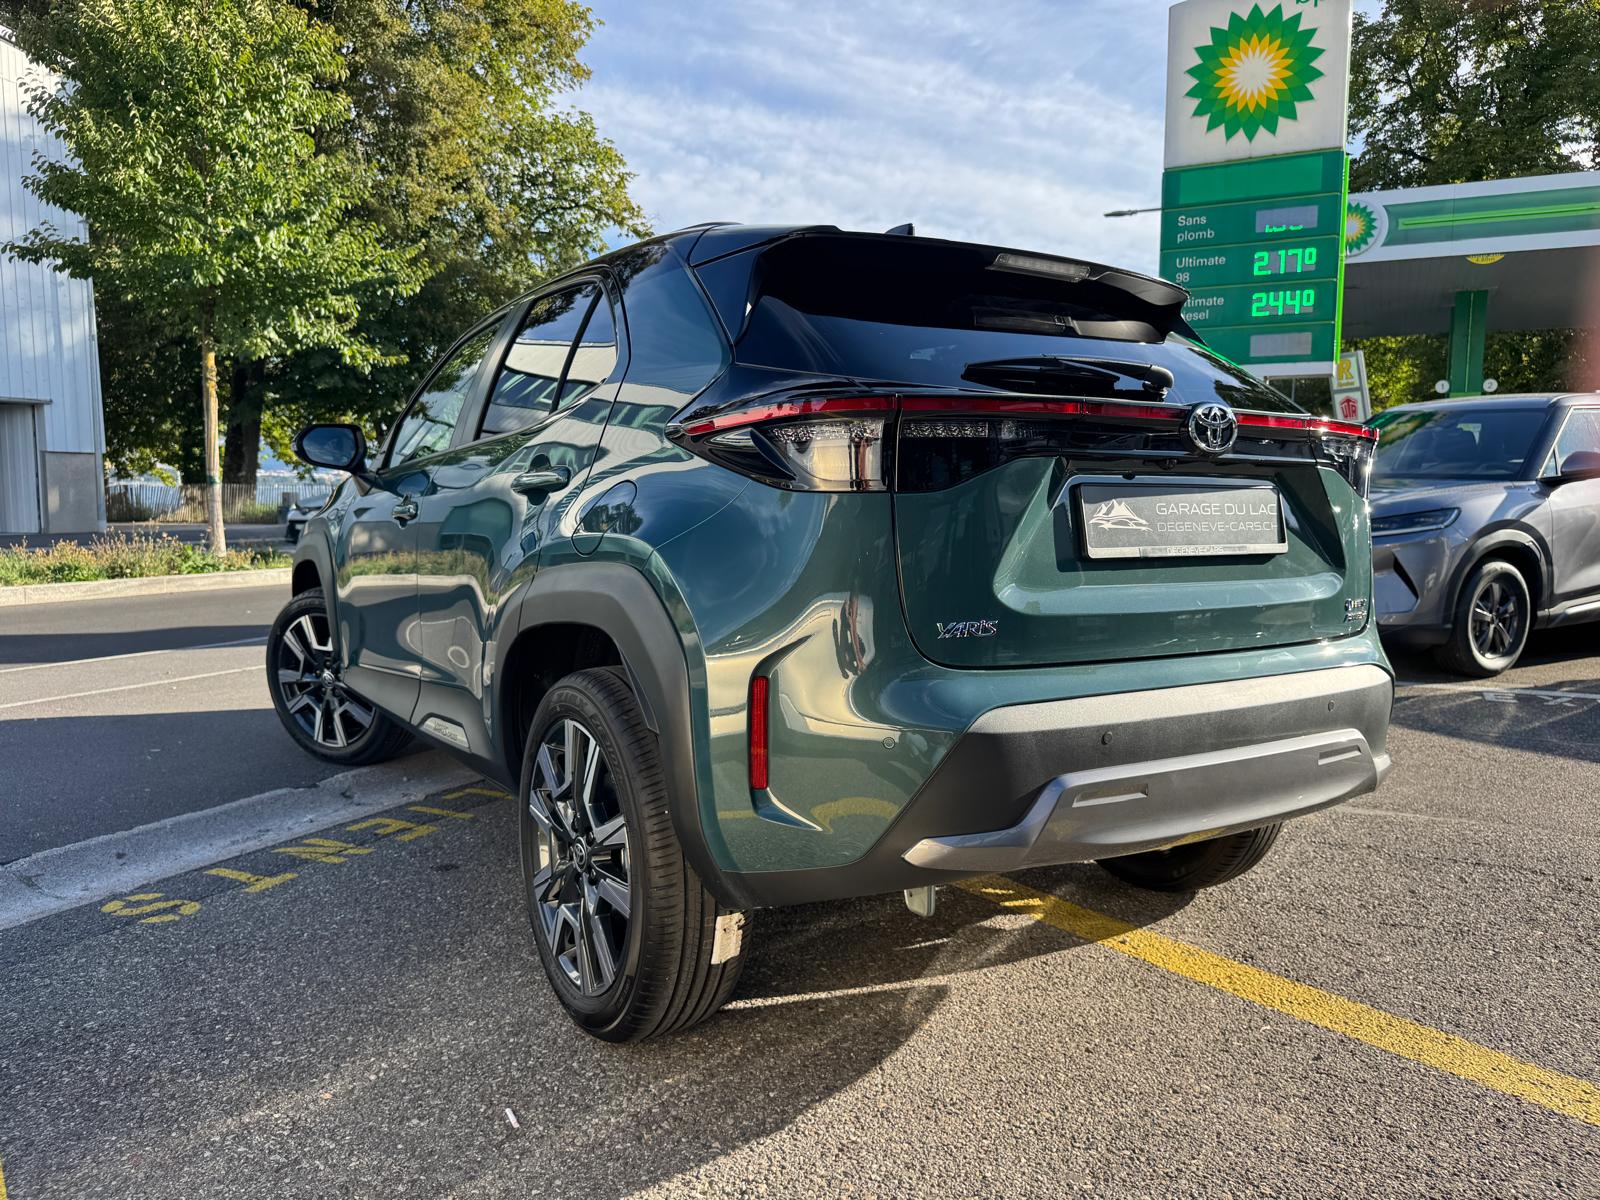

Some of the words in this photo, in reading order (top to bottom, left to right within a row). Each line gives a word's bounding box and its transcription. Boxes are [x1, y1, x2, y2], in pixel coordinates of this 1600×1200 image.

[1177, 215, 1207, 227] Sans
[1176, 228, 1215, 244] plomb
[1176, 255, 1226, 269] Ultimate
[1175, 272, 1190, 283] 98
[1184, 296, 1225, 307] timate
[1183, 309, 1209, 322] iesel
[1156, 503, 1221, 515] GARAGE
[1225, 503, 1246, 515] DU
[1249, 503, 1277, 515] LAC
[1482, 692, 1600, 707] EX
